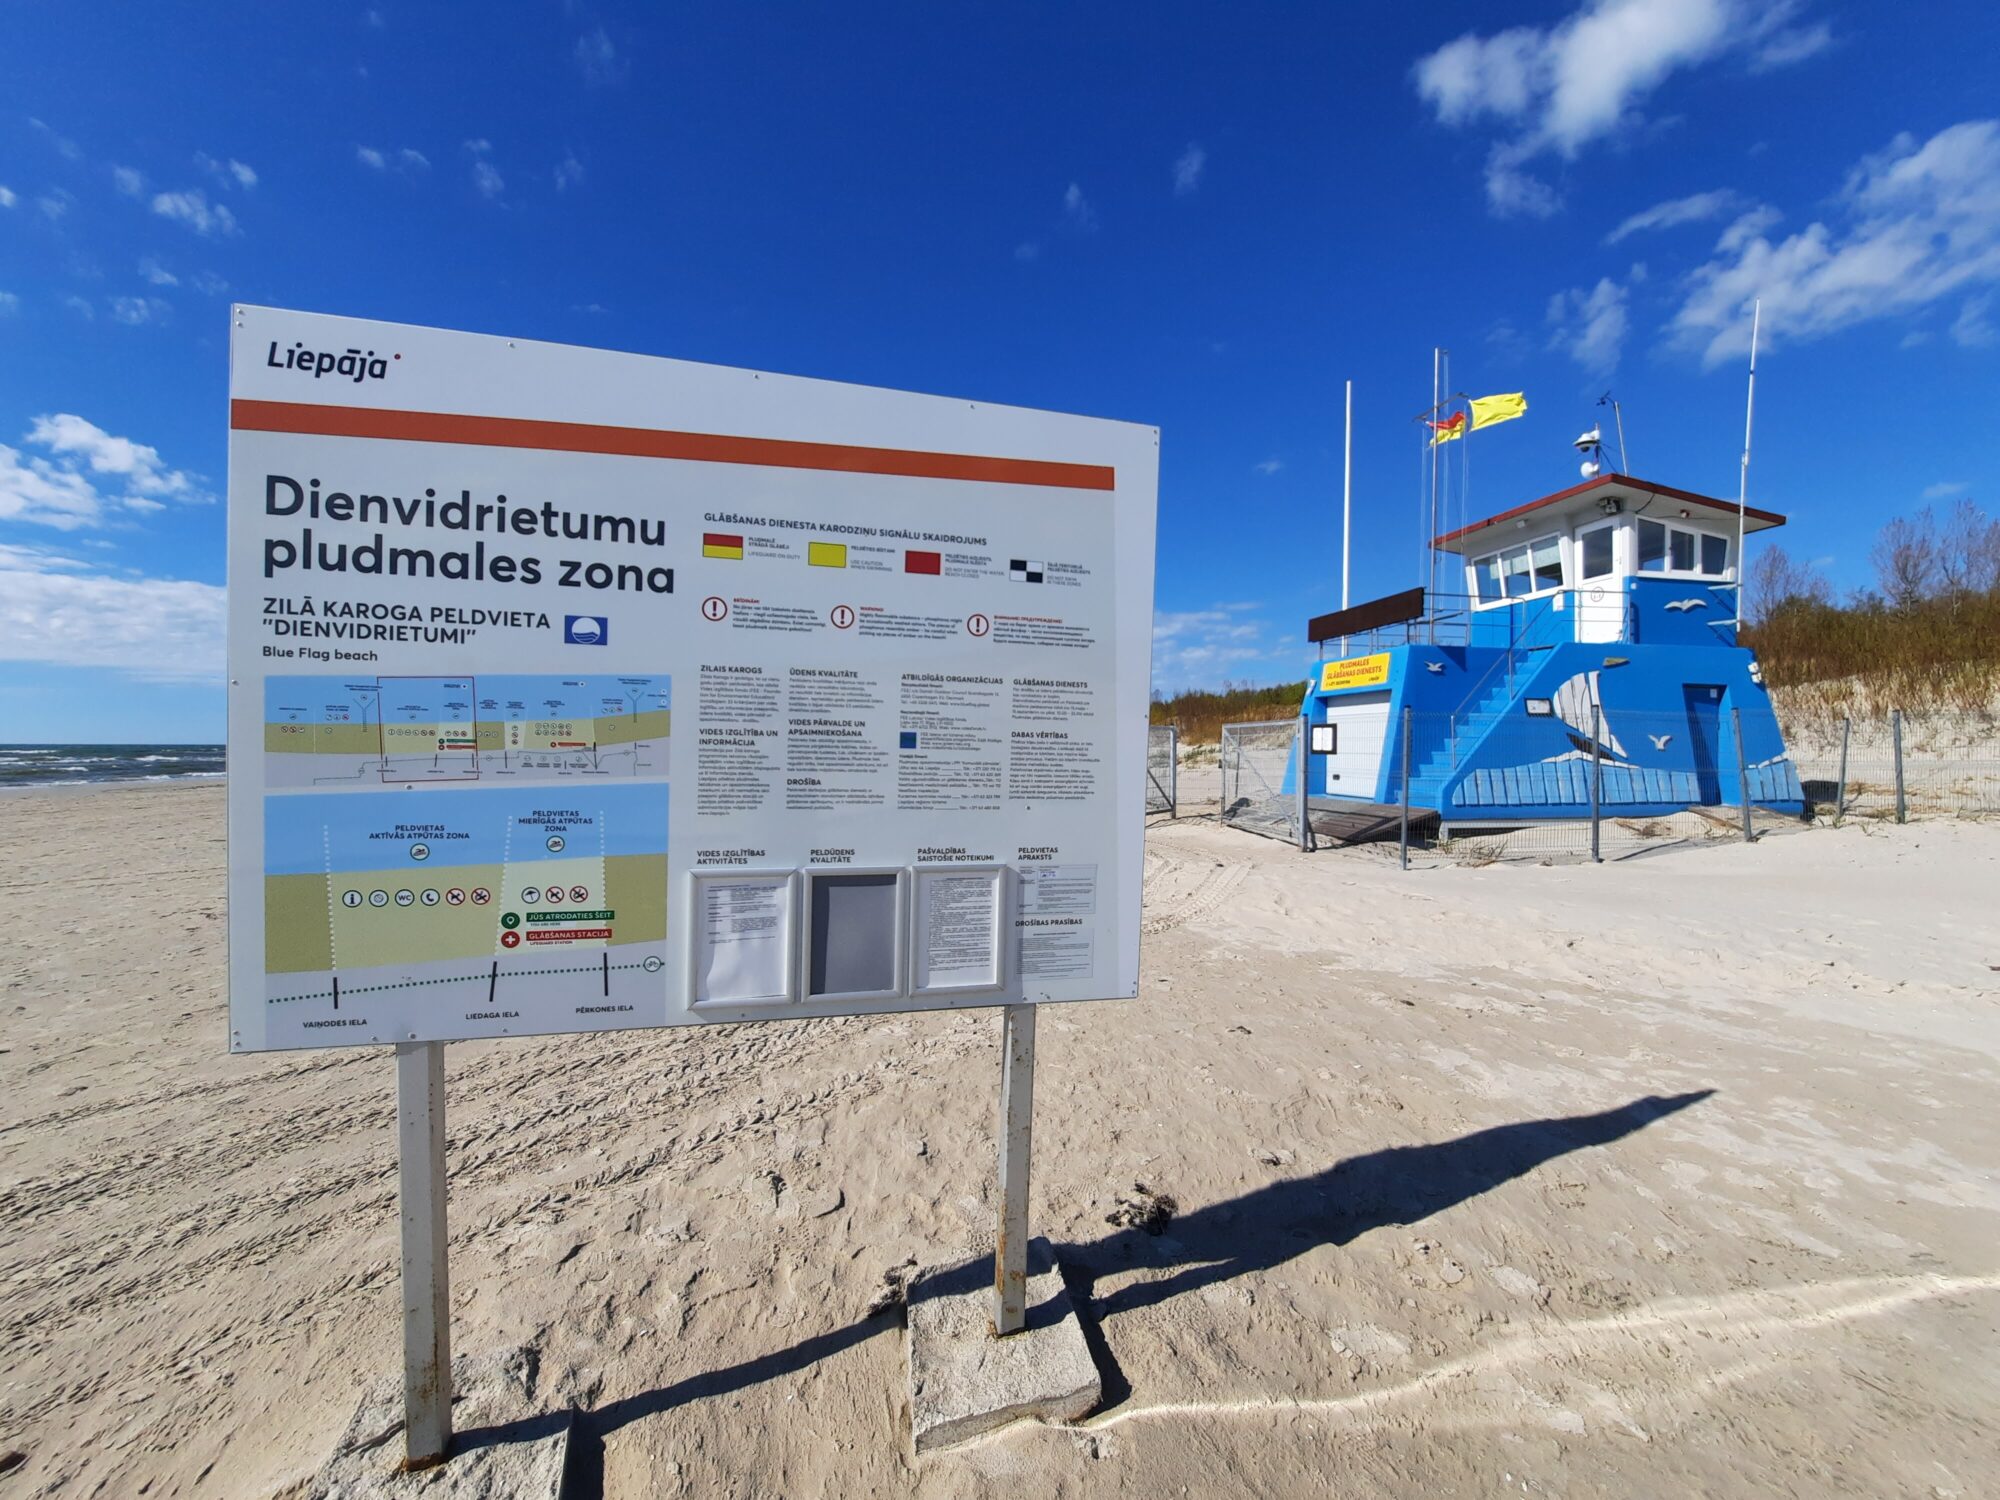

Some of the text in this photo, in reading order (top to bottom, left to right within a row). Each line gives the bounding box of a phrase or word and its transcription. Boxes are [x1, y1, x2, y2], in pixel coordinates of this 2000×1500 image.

[267, 341, 388, 382] Liepāja
[265, 474, 666, 546] Dienvidrietumu
[704, 512, 987, 546] GLĀBŠANAS DIENESTA KARODZIŅU SIGNĀLU SKAIDROJUMS
[264, 528, 675, 594] pludmales zona
[263, 596, 551, 629] ZILĀ KAROGA PELDVIETA
[262, 646, 378, 662] Blue Flag beach
[1339, 659, 1369, 669] PLUDMALES
[700, 664, 763, 674] ZILAIS KAROGS
[789, 667, 858, 678] ŪDENS KVALITĀTE
[1356, 666, 1382, 676] DIENESTS
[901, 673, 1003, 685] ATBILDĪGĀS ORGANIZĀCIJAS
[1013, 678, 1088, 689] GLĀBŠANAS DIENESTS
[789, 718, 812, 726] VIDES
[813, 717, 852, 727] PĀRVALDE
[699, 728, 724, 736] VIDES
[766, 729, 779, 737] UN
[788, 727, 862, 737] APSAIMNIEKOŠANA
[1011, 731, 1068, 739] DABAS VĒRTĪBAS
[699, 738, 756, 746] INFORMĀCIJA
[786, 777, 822, 786] DROŠĪBA
[532, 810, 580, 818] PELDVIETAS
[518, 817, 593, 826] MIERĪGĀS ATPŪTAS
[394, 824, 445, 832] PELDVIETAS
[369, 831, 470, 840] AKTĪVĀS ATPŪTAS ZONA
[722, 848, 766, 857] IZGLĪTĪBAS
[810, 848, 855, 856] PELDŪDENS
[917, 846, 966, 855] PAŠVALDĪBAS
[696, 855, 748, 865] AKTIVITĀTES
[810, 855, 851, 863] KVALITĀTE
[917, 853, 994, 862] SAISTOŠIE NOTEIKUMI
[1018, 853, 1053, 861] APRAKSTS
[528, 911, 611, 920] JŪS ATRODATIES ŠEIT
[1015, 917, 1082, 927] DROŠĪBAS PRASĪBAS
[528, 931, 609, 940] GLĀBŠANAS STACIJA
[575, 1005, 615, 1014] PĒRKONES
[465, 1011, 519, 1020] LIEDAGA IELA
